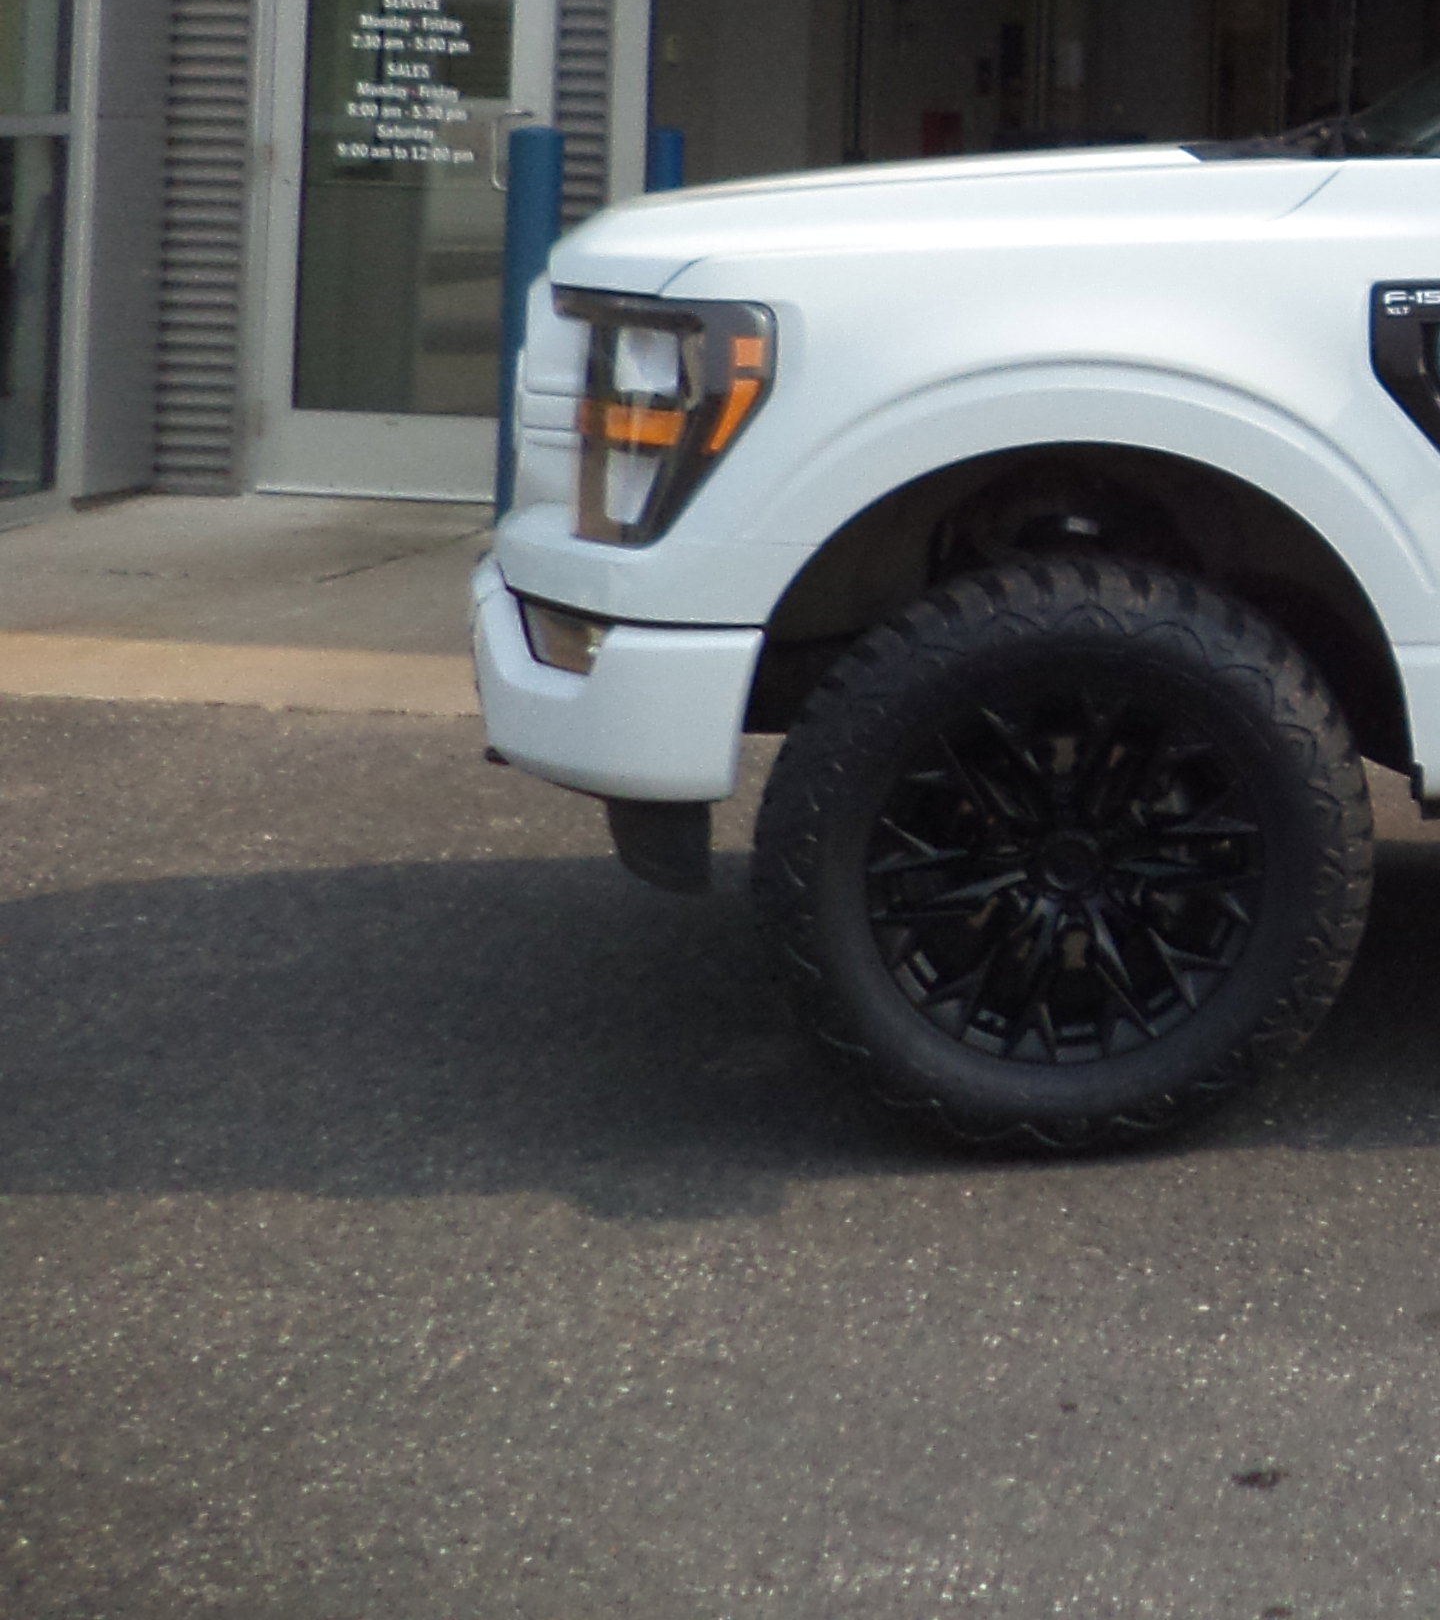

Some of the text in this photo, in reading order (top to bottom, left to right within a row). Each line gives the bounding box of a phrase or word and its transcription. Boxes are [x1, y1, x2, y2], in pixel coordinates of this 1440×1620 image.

[359, 14, 411, 32] Monday
[387, 63, 430, 79] SALES
[376, 124, 435, 142] Saturday
[394, 145, 409, 160] to
